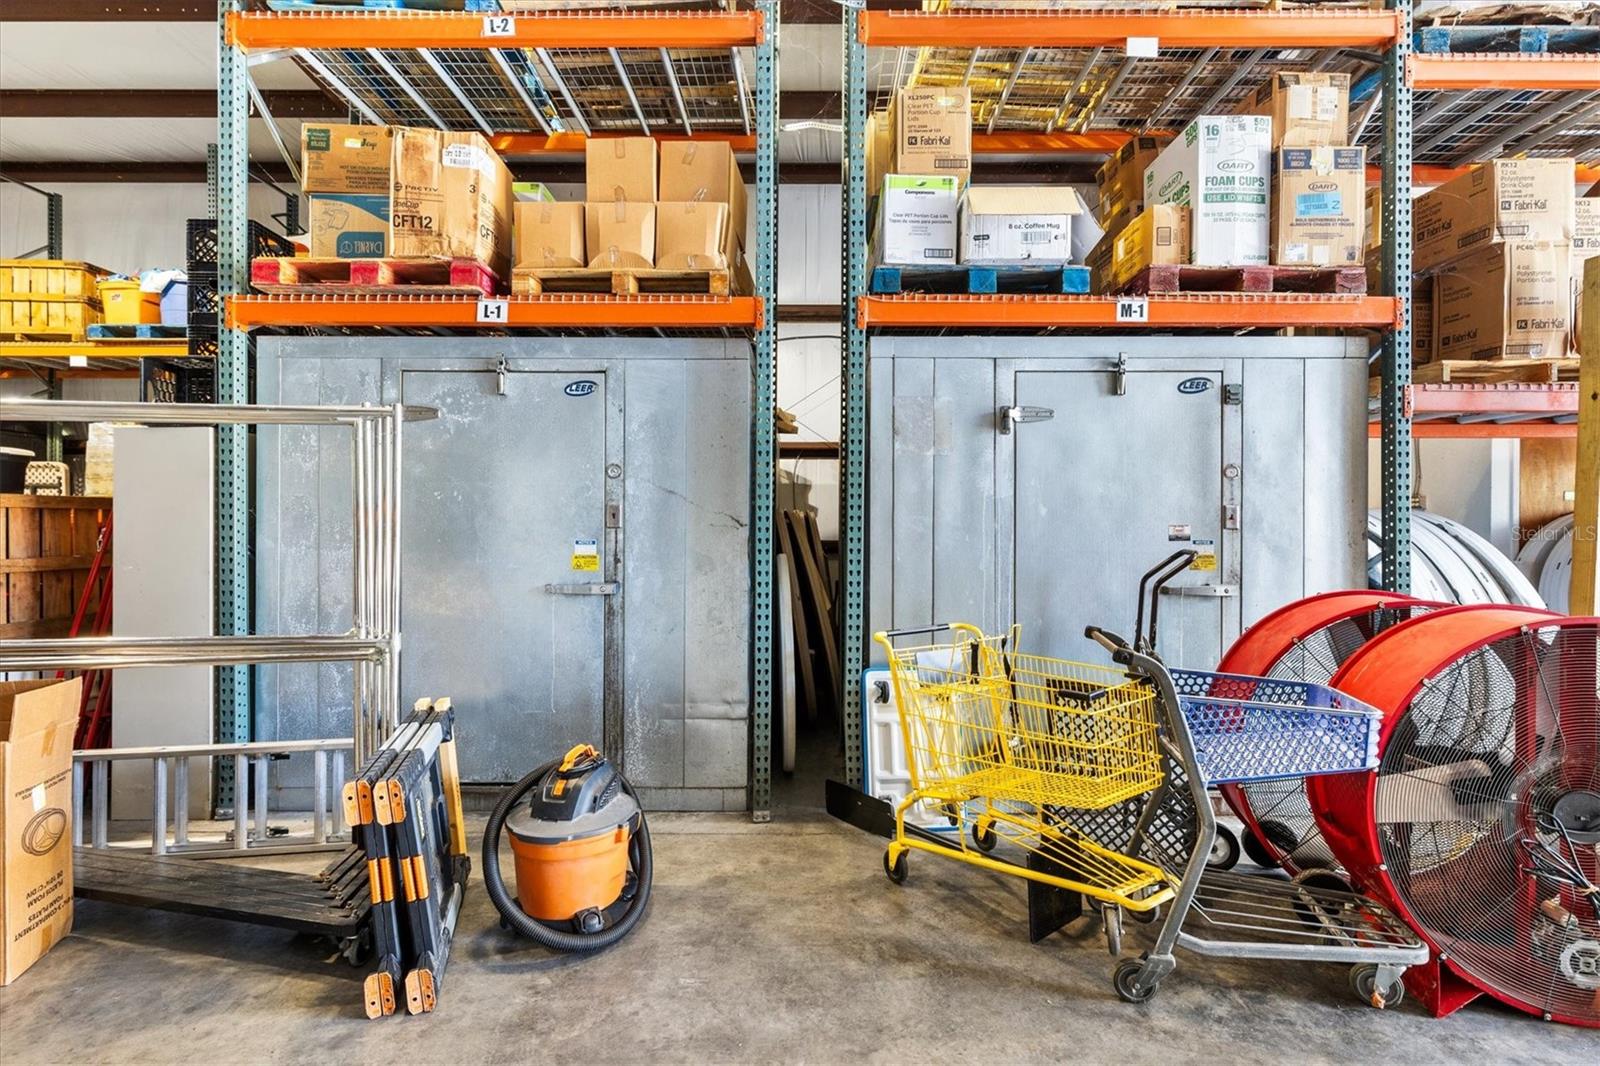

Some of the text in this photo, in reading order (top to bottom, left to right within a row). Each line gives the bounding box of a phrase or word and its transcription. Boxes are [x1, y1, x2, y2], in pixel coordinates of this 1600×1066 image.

[490, 18, 509, 33] L-2
[1205, 125, 1219, 136] 16
[1205, 176, 1264, 187] FOAM CUPS
[469, 185, 476, 193] 3
[1332, 200, 1340, 209] 2
[393, 214, 432, 229] CFT12
[354, 241, 383, 254] DARNEL
[484, 304, 501, 318] L-1
[1120, 304, 1144, 318] M-1
[1182, 381, 1208, 389] LEER
